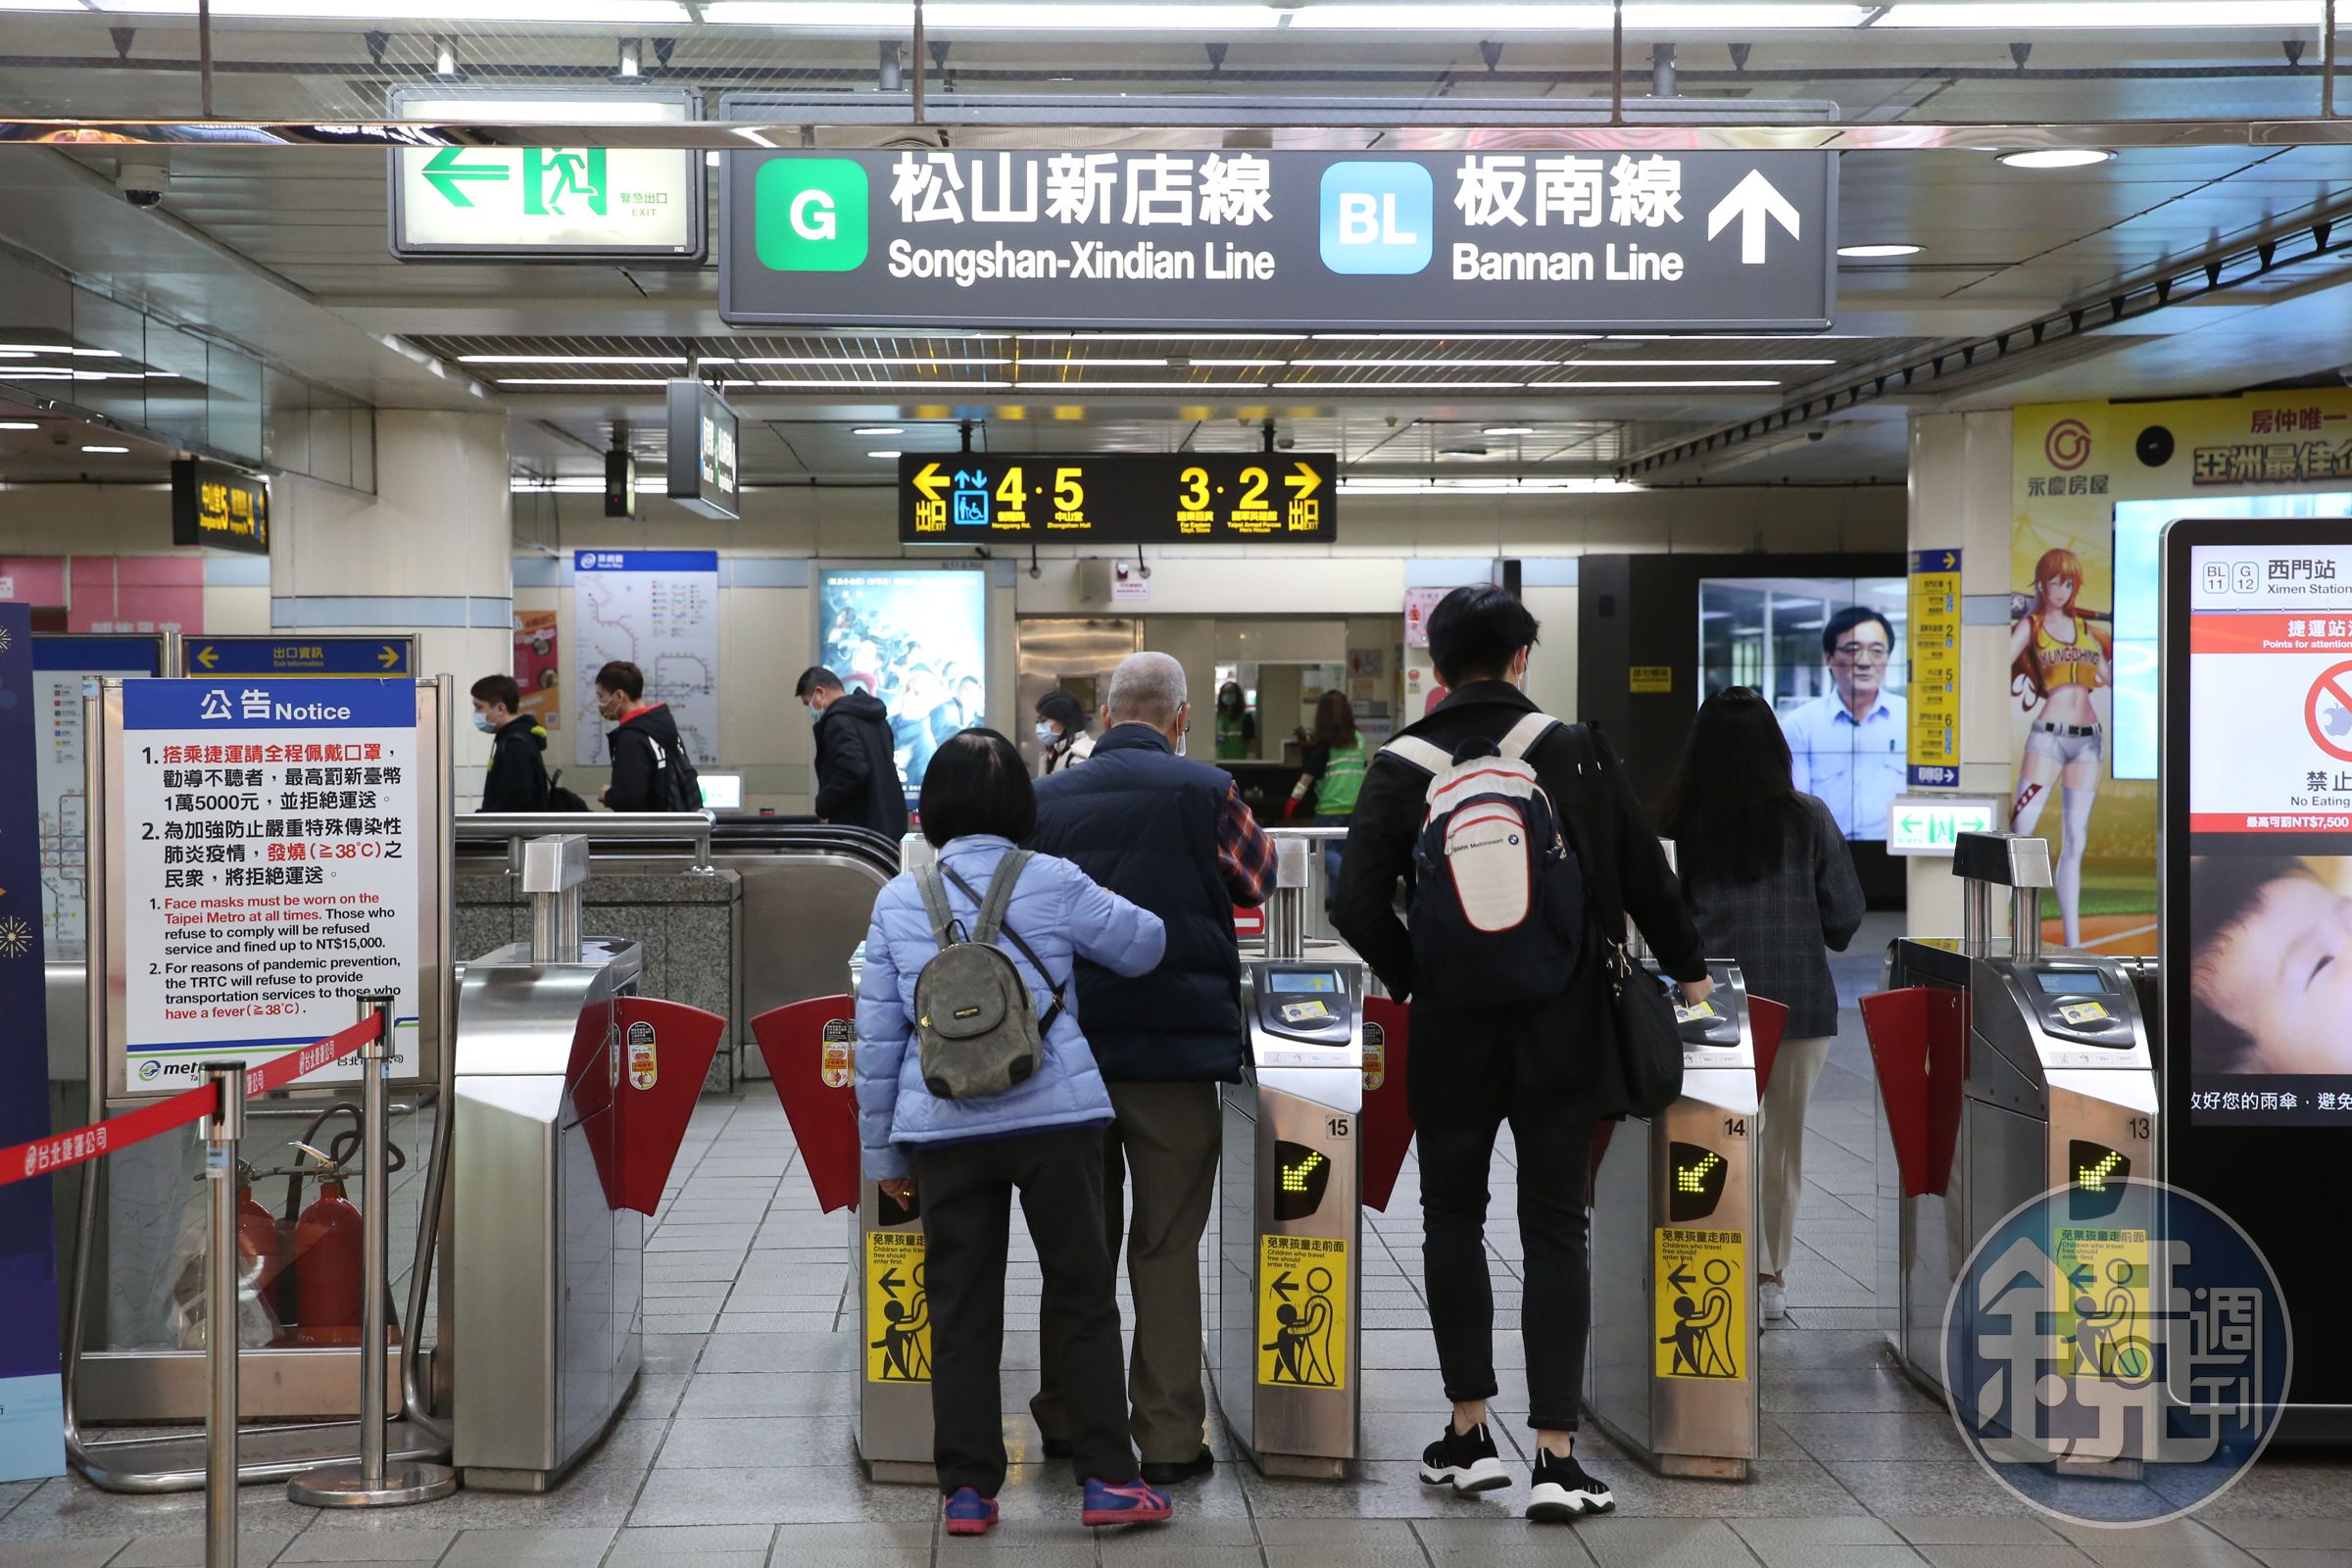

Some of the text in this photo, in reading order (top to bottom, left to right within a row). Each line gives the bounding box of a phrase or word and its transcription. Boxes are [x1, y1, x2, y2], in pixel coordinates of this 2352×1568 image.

[620, 192, 667, 204] 緊急出口
[891, 152, 1273, 226] 松山新店線
[1454, 154, 1684, 227] 板南線
[632, 208, 657, 217] EXIT
[790, 190, 836, 240] G
[1339, 193, 1417, 245] BL
[889, 239, 1275, 287] Songshan-Xindian Line
[1452, 243, 1684, 281] Bannan Line
[2250, 407, 2347, 433] 房仲唯一
[996, 466, 1084, 512] 4 5
[1180, 466, 1269, 511] 3 2
[2028, 475, 2109, 496] 永慶房屋
[2208, 566, 2226, 577] BL
[2240, 566, 2251, 577] G
[2268, 560, 2335, 579] 西門站
[2209, 579, 2223, 590] 11
[2238, 579, 2253, 590] 12
[2267, 584, 2352, 594] Ximen Station
[1946, 624, 1953, 637] 2
[2288, 620, 2352, 637] 捷運站
[273, 647, 323, 659] 出口資訊
[1946, 668, 1952, 681] 5
[200, 689, 271, 720] 公告
[274, 703, 351, 720] Notice
[1945, 713, 1952, 726] 6
[2291, 797, 2350, 808] No Eating
[165, 817, 402, 839] 為加強防止嚴重特殊傳染性
[150, 893, 379, 909] 1. Face masks must be worn on the
[165, 906, 395, 926] Taipei Metro at all times. Those who
[165, 922, 369, 940] refuse to comply will be refused
[165, 937, 385, 956] service and fined up to NT$15,000.
[149, 956, 401, 975] 2. For reasons of pandemic prevention,
[165, 971, 364, 989] the TRTC will refuse to provide
[165, 985, 401, 1005] transportation services to those who
[165, 1008, 197, 1019] have
[201, 1009, 208, 1018] a
[305, 1040, 335, 1071] 台北捷運公司
[164, 1062, 200, 1075] met
[1328, 1119, 1348, 1136] 15
[1725, 1118, 1745, 1136] 14
[2130, 1118, 2150, 1140] 13
[39, 1127, 107, 1169] 台北捷運公司
[1268, 1237, 1344, 1252] 免票孩童走前面
[1663, 1229, 1740, 1244] 免票孩童走前面
